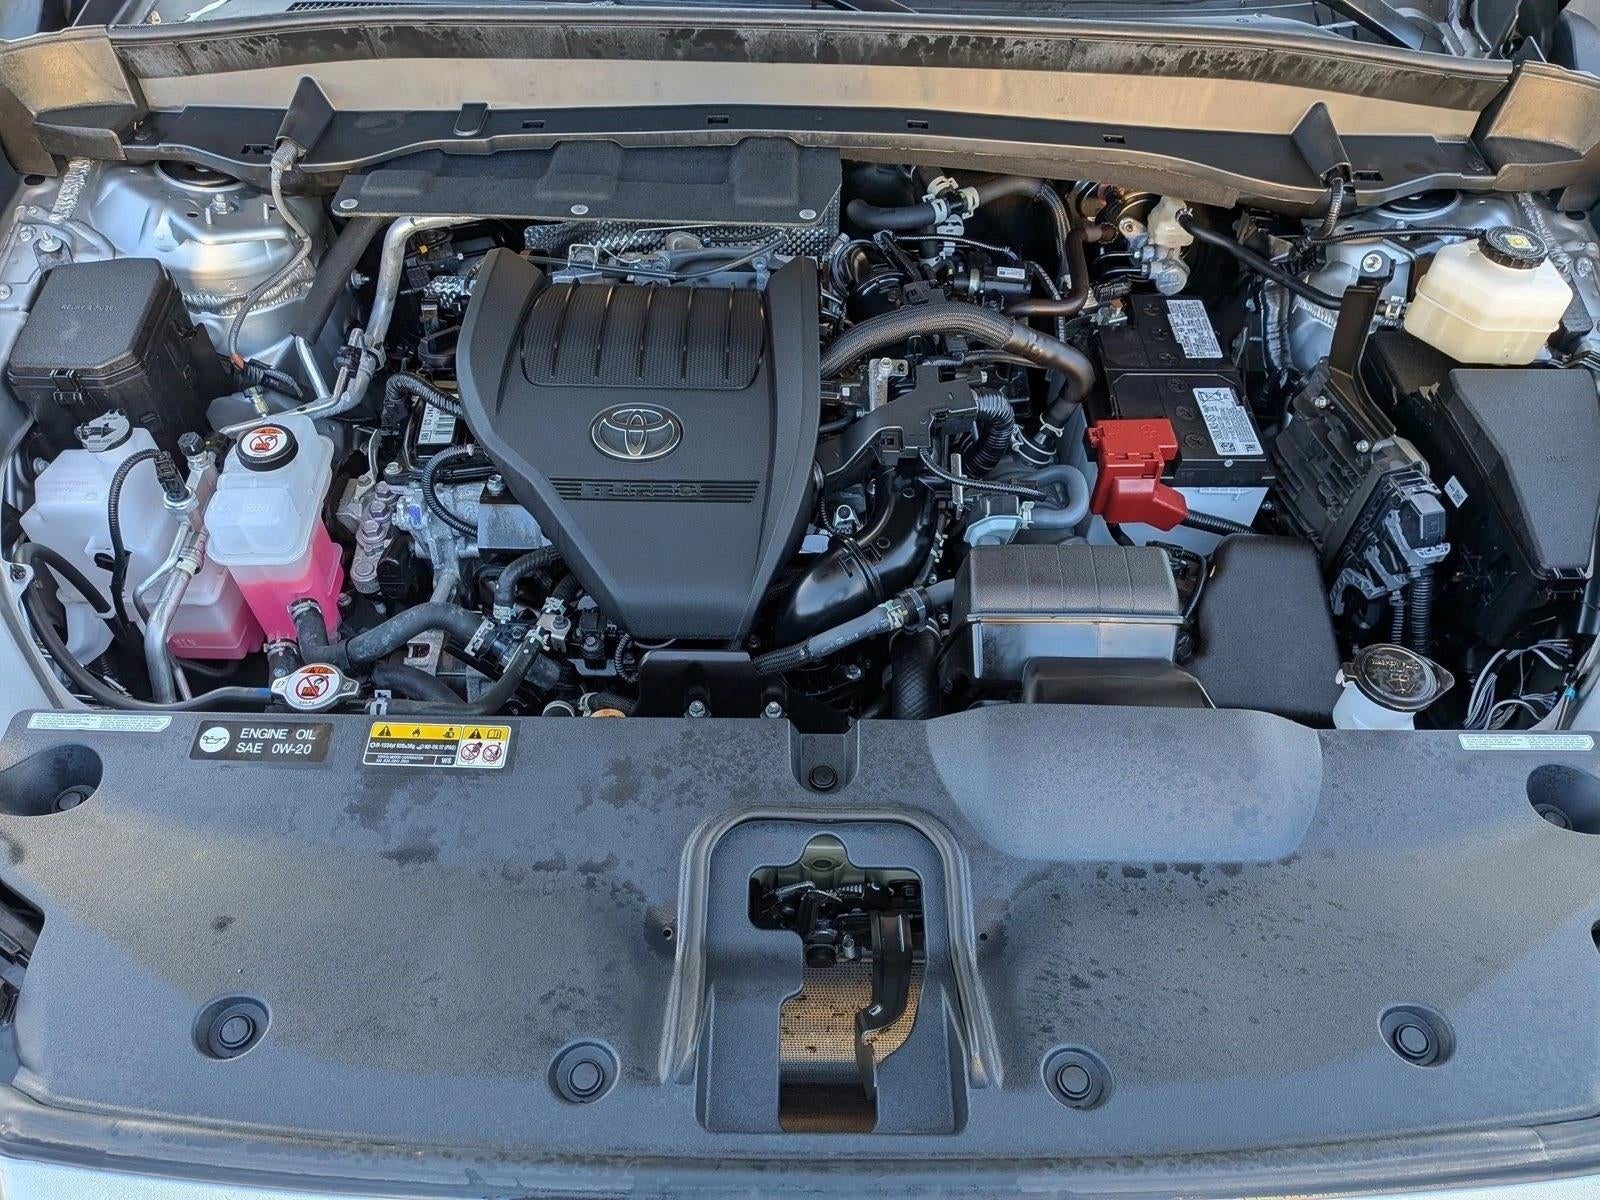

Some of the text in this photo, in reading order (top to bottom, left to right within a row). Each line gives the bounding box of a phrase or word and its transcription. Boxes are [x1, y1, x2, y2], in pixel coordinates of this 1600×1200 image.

[580, 481, 699, 497] TURBO
[240, 728, 316, 740] ENGINE OIL
[235, 742, 312, 754] SAE 0W-20
